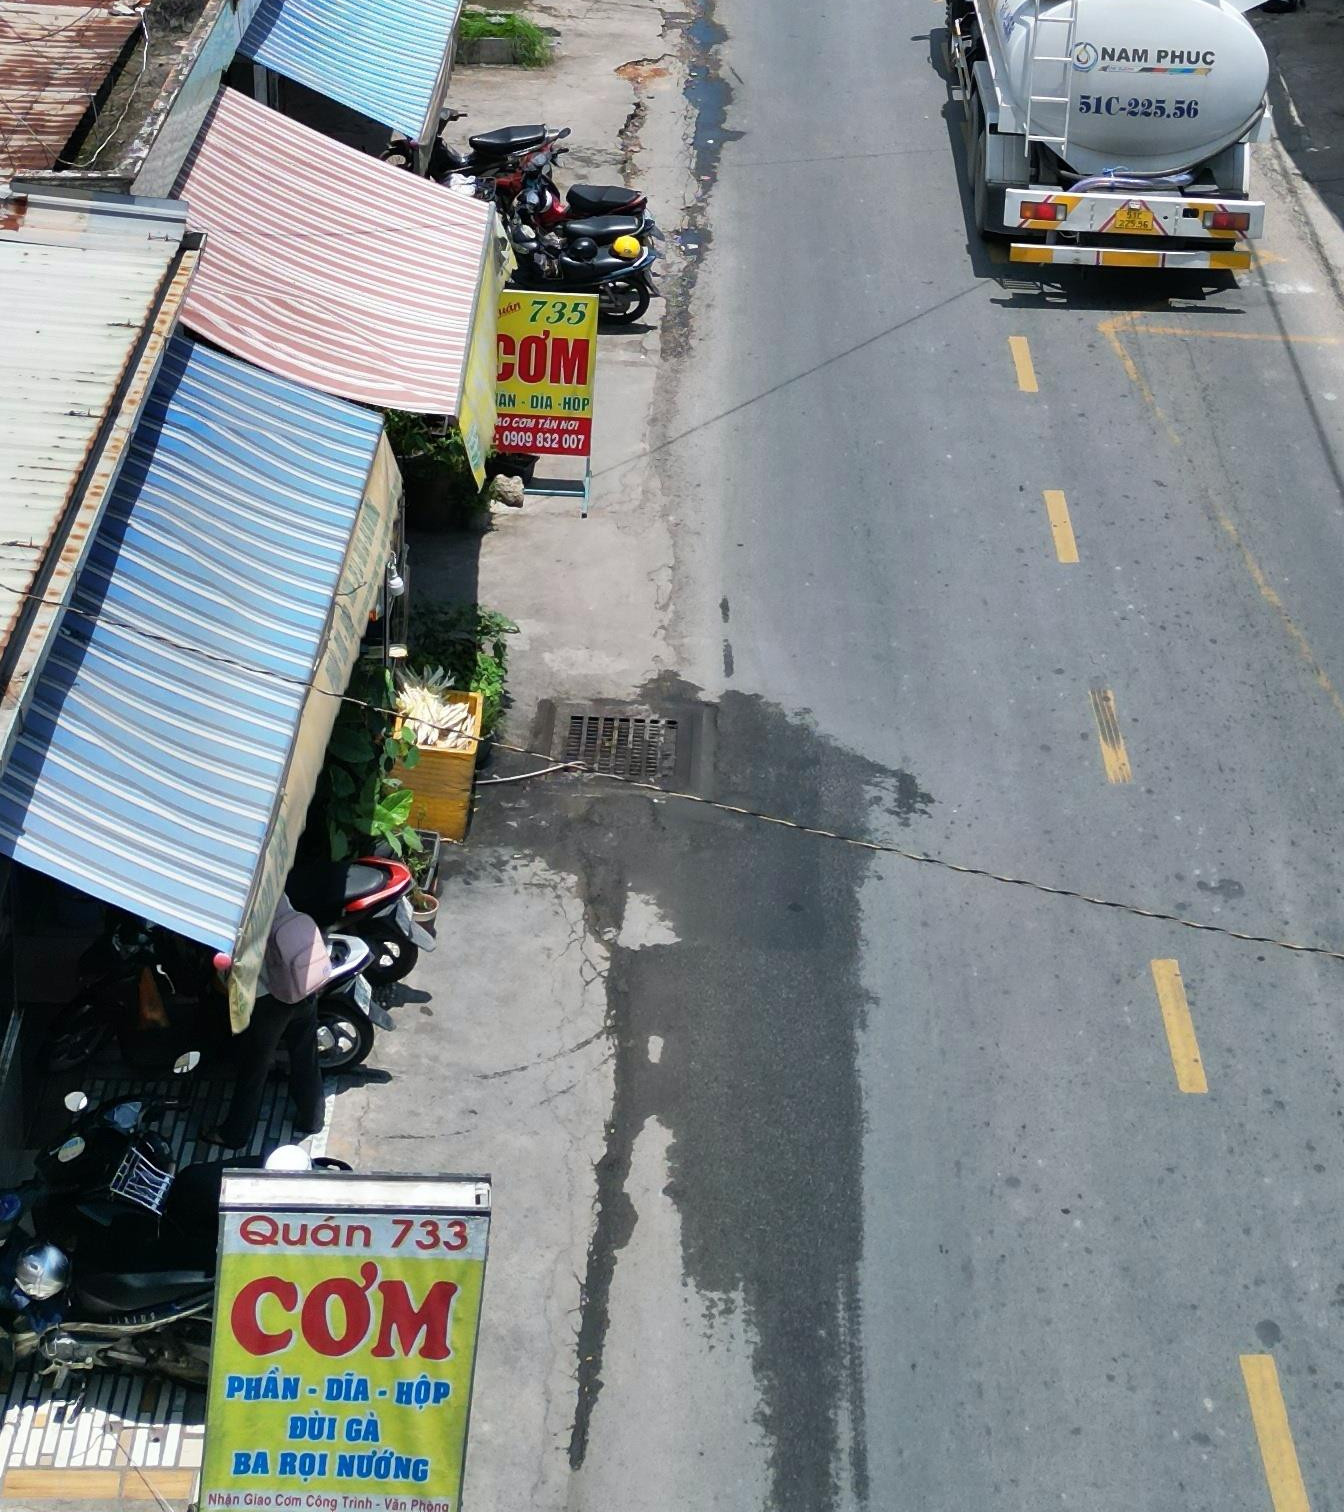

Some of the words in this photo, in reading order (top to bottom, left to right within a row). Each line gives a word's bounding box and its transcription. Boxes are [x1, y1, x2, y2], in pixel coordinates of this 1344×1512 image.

[1101, 46, 1149, 63] NAM
[1156, 49, 1216, 66] PHUC
[1078, 94, 1200, 119] 51C-225.56
[497, 300, 522, 320] uán
[529, 299, 589, 325] 735
[496, 329, 590, 386] CƠM
[503, 430, 533, 447] 0909
[536, 433, 559, 448] 832
[562, 434, 585, 450] 007
[238, 1214, 373, 1248] Quán
[390, 1218, 469, 1252] 733
[230, 1260, 459, 1361] CƠM
[225, 1366, 301, 1401] PHẦN
[324, 1372, 370, 1402] DĨA
[394, 1373, 452, 1411] HỘP
[287, 1409, 337, 1441] ĐÙI
[344, 1411, 381, 1443] GÀ
[232, 1451, 270, 1476] BA
[277, 1452, 328, 1483] RỌI
[336, 1450, 430, 1482] NƯỚNG
[207, 1492, 240, 1507] Nhận
[243, 1492, 272, 1507] Giao
[275, 1494, 303, 1508] Cơm
[305, 1492, 338, 1511] Công
[341, 1494, 374, 1510] Trình
[384, 1496, 408, 1511] Văn
